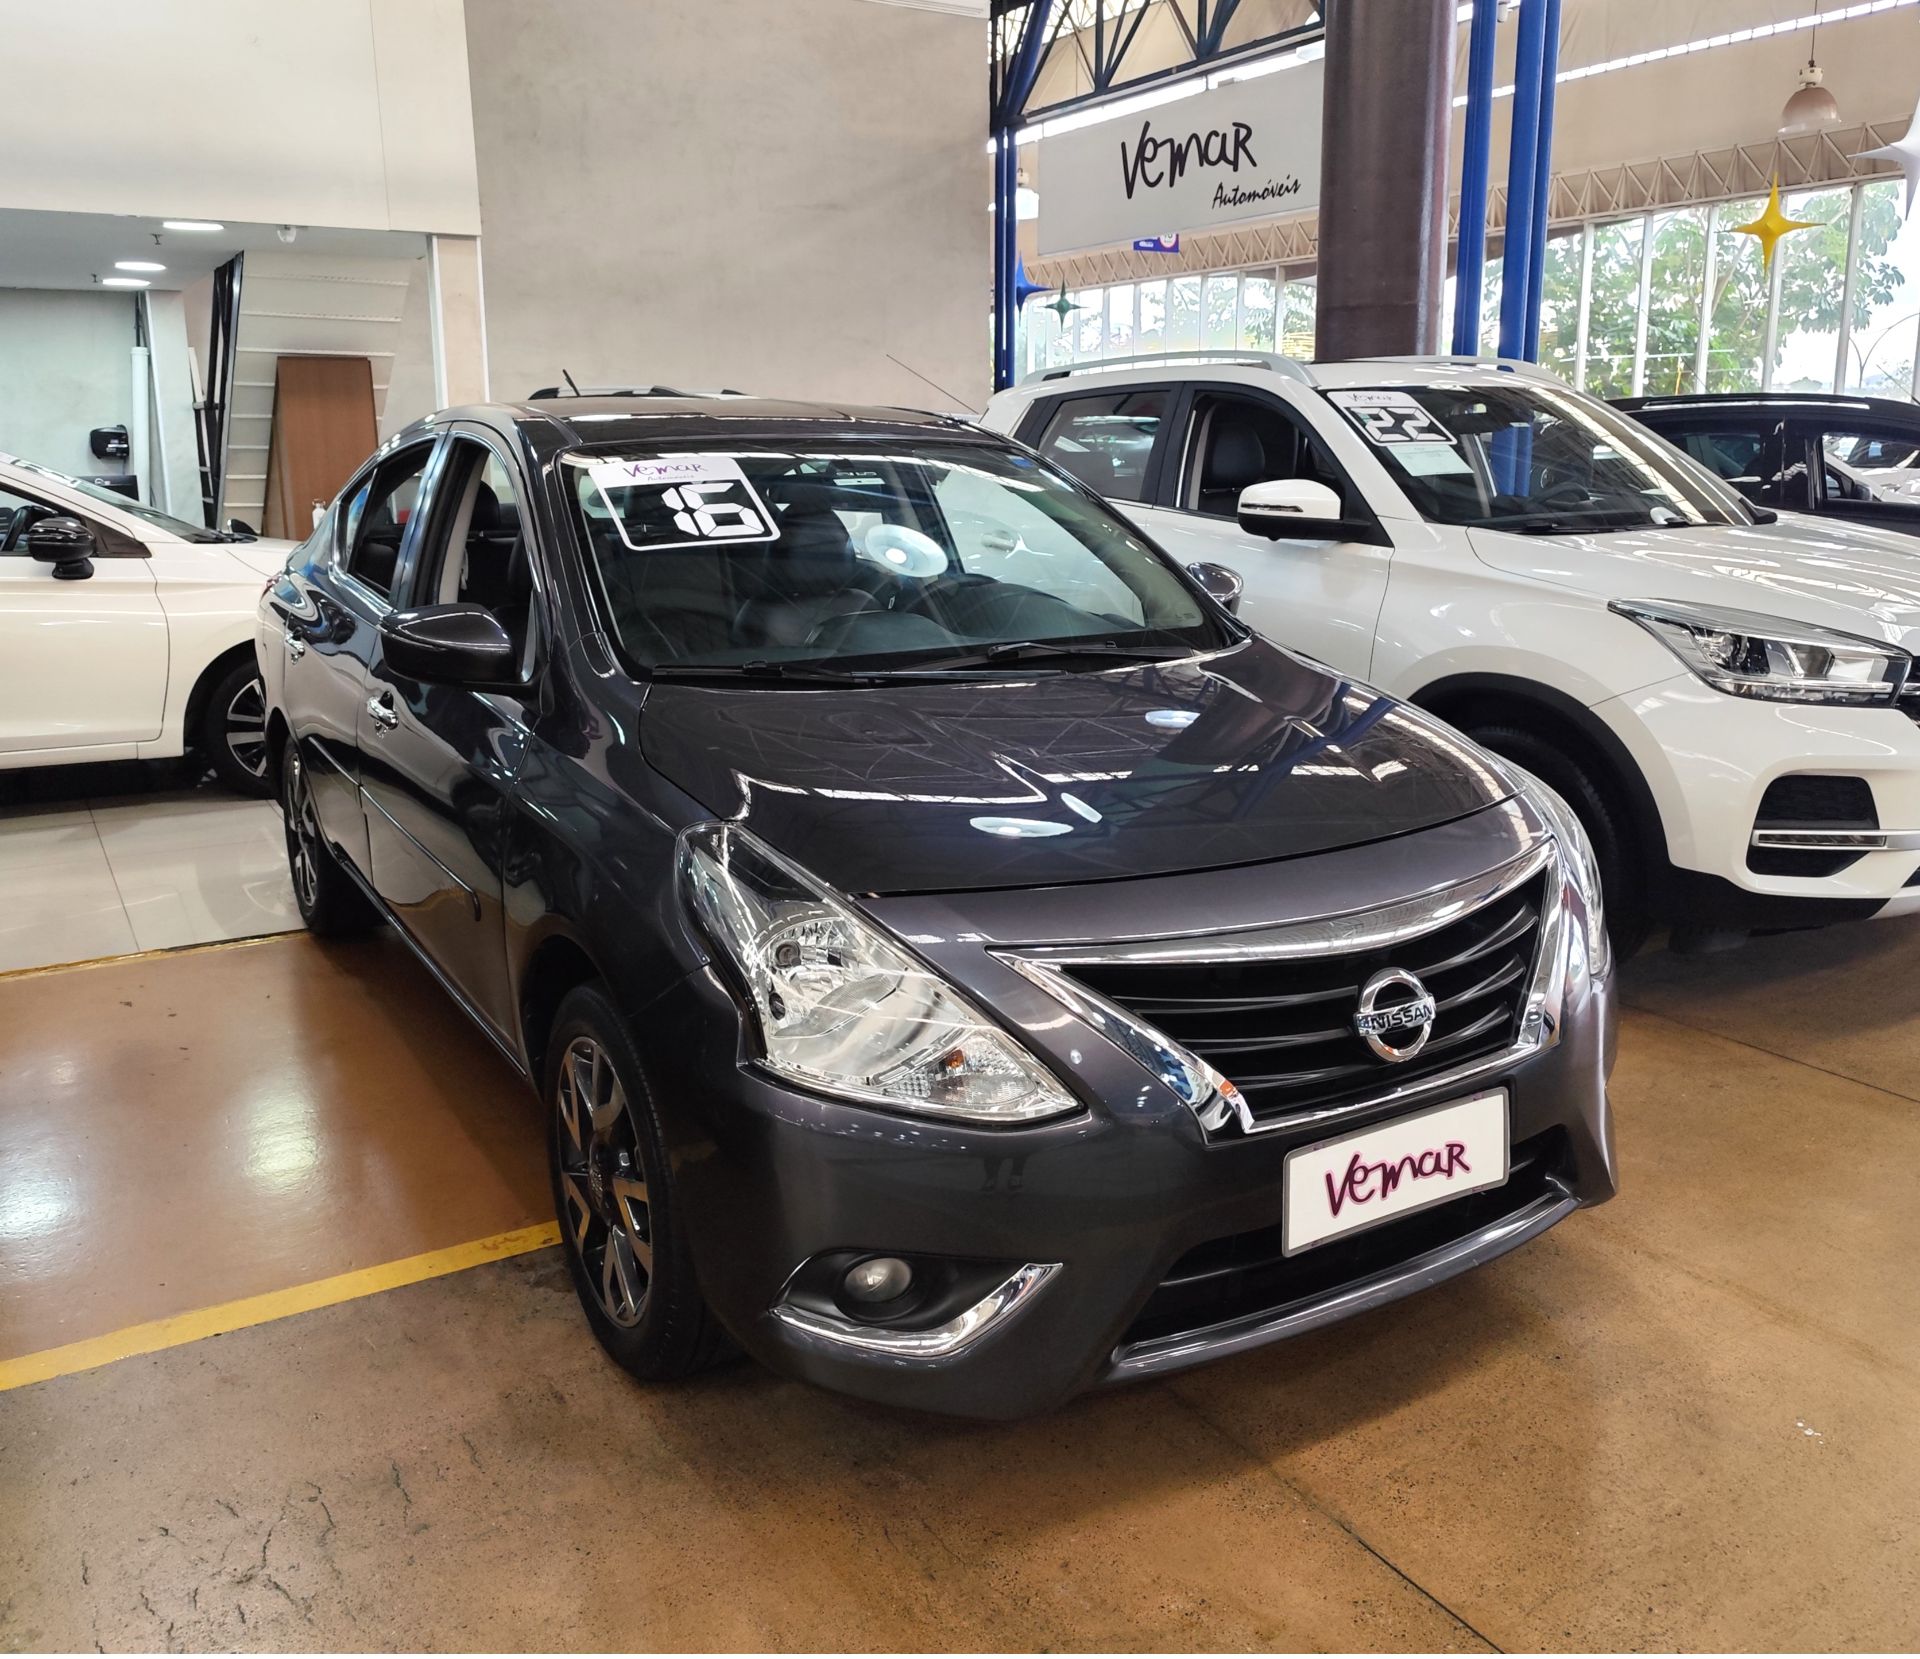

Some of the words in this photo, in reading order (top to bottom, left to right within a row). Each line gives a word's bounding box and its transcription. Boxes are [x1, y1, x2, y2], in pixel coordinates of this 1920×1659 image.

[1211, 174, 1302, 210] Automóveis
[1349, 407, 1447, 441] 22
[661, 482, 765, 538] 16
[1371, 1003, 1433, 1030] NISSAN
